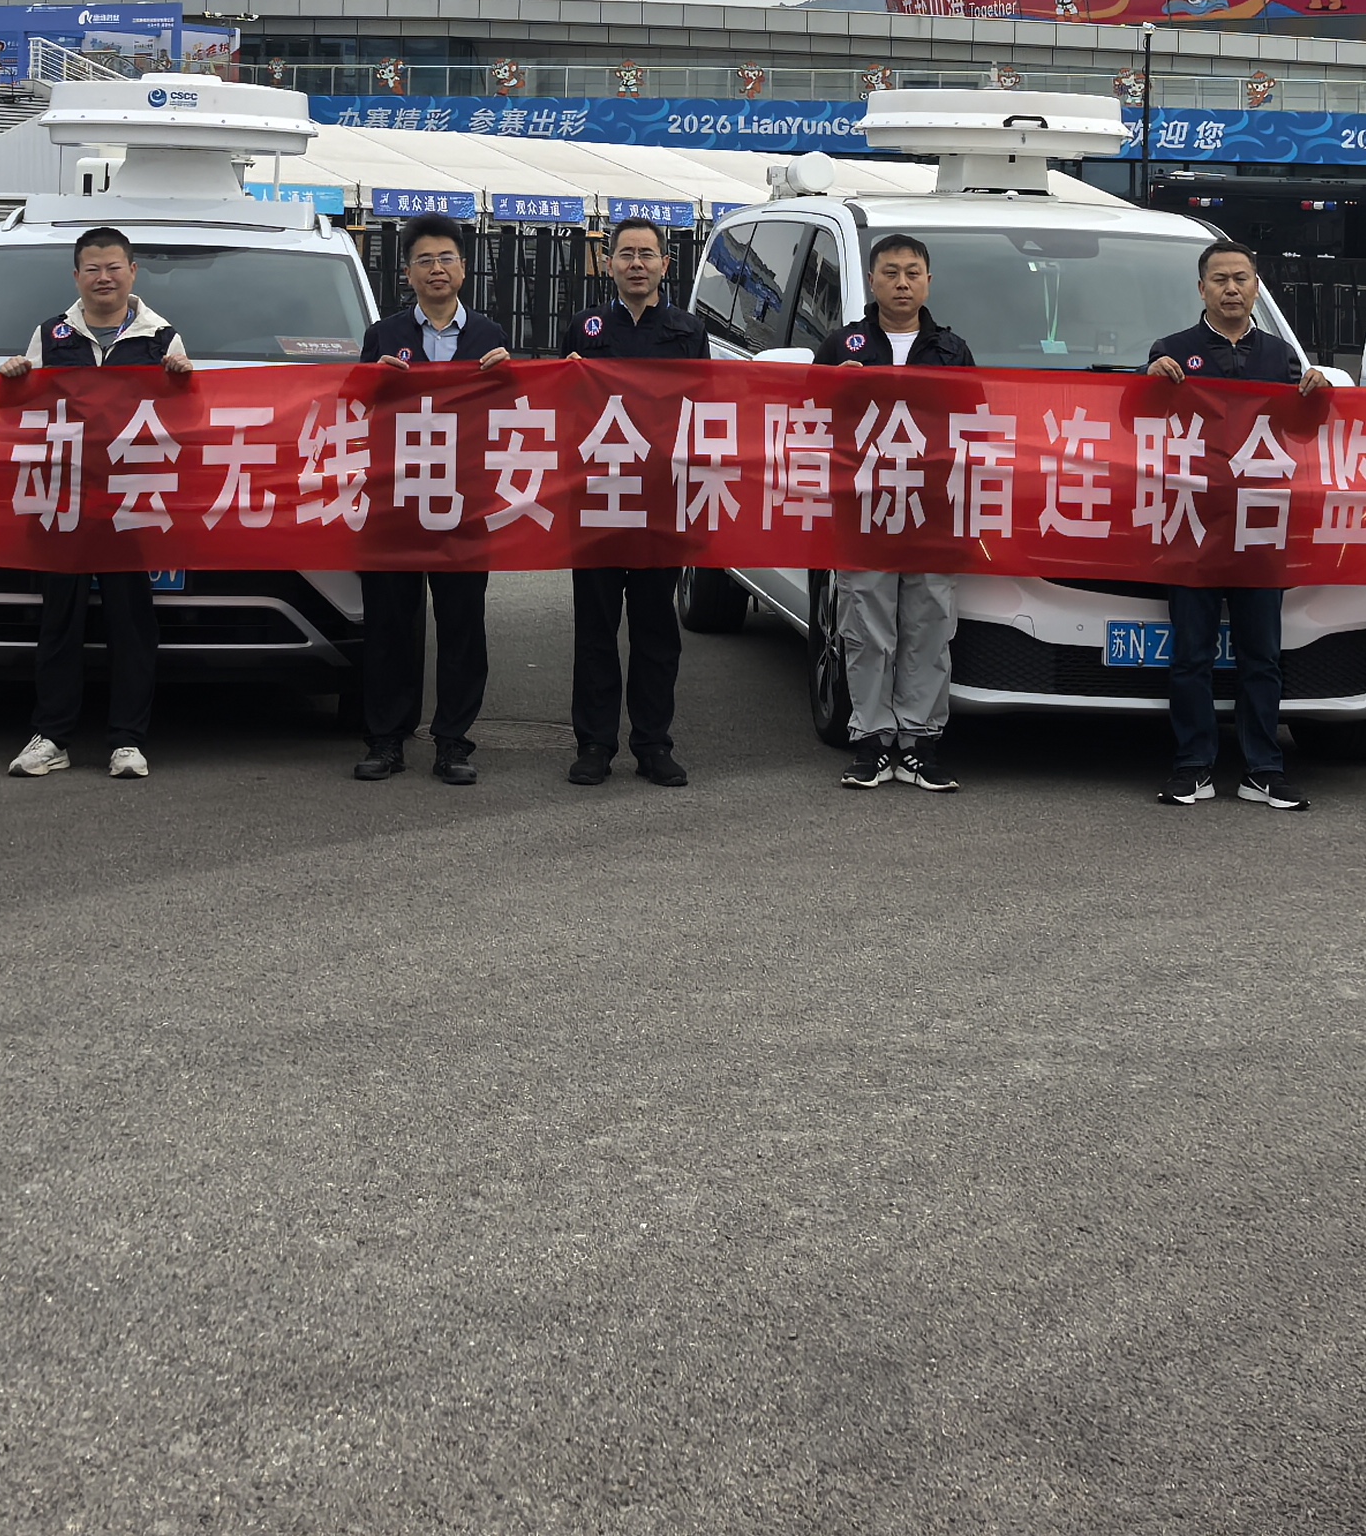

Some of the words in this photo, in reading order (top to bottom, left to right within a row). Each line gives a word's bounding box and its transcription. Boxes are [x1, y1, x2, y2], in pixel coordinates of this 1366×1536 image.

[968, 0, 1017, 17] Together
[170, 92, 198, 101] CSCC
[337, 107, 452, 132] 办赛精彩
[469, 107, 588, 136] 参赛出彩
[667, 114, 732, 134] 2026
[738, 115, 864, 136] LianYunGa
[398, 195, 449, 212] 观众通道
[515, 200, 561, 216] 观众通道
[629, 204, 672, 221] 观众通道
